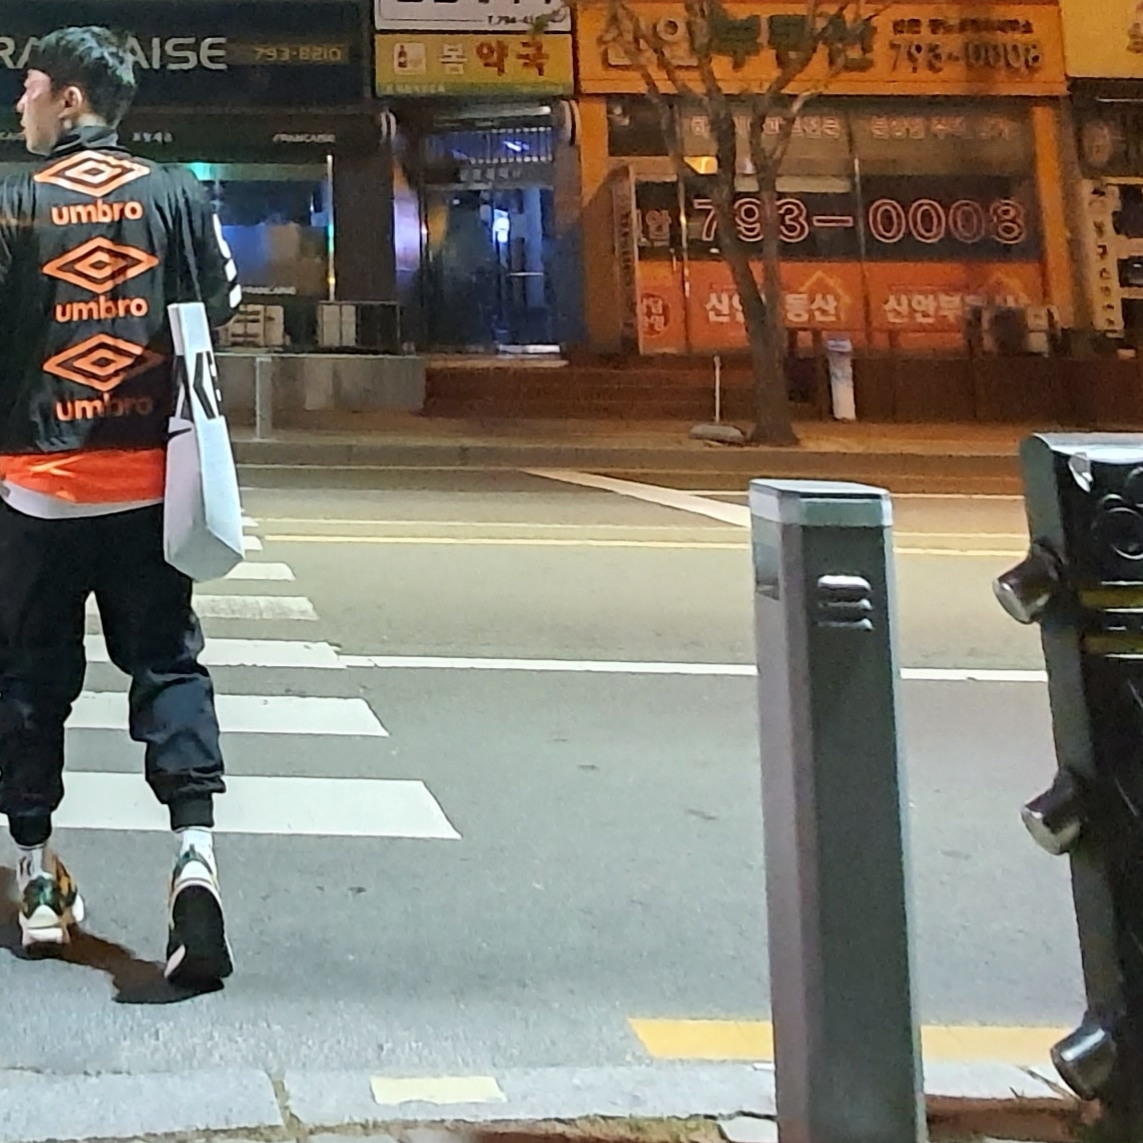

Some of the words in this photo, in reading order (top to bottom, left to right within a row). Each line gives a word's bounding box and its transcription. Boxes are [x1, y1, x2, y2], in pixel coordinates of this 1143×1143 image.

[51, 200, 145, 226] umbro
[693, 198, 1026, 244] 793-0008
[55, 295, 148, 324] umbro
[56, 392, 153, 422] umbro
